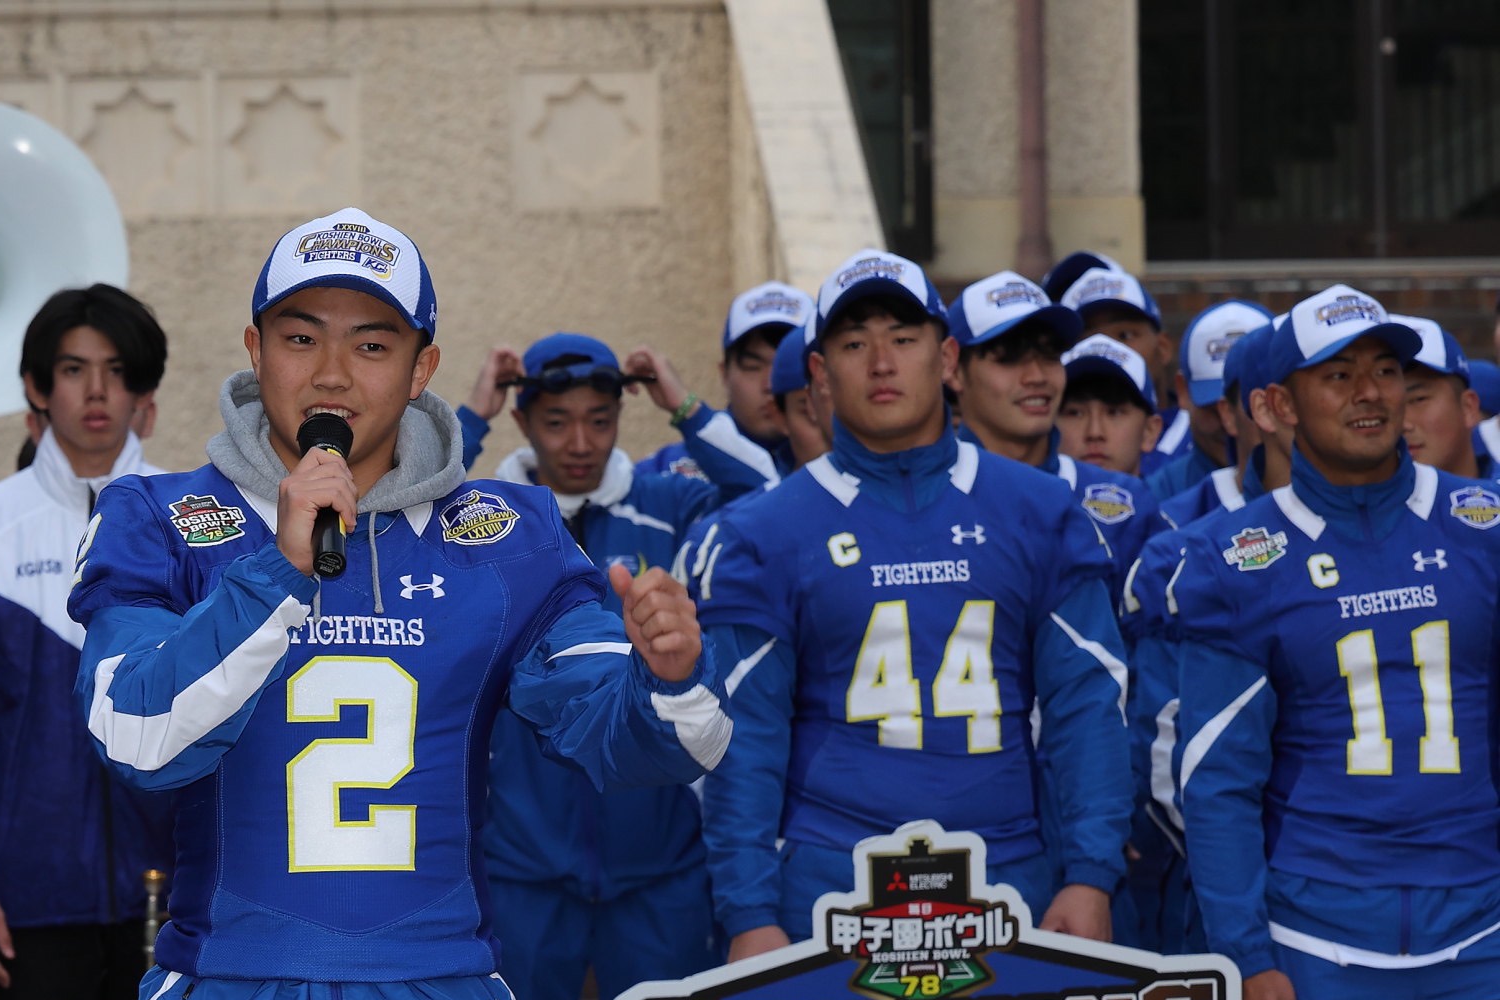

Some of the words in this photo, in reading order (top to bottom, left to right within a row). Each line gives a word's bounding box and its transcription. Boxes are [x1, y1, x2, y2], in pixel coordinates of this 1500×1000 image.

[316, 231, 356, 240] KOSHIEN
[358, 233, 381, 247] BOWL
[336, 224, 367, 233] LXXVIII
[299, 234, 397, 262] CHAMPIONS
[308, 251, 356, 261] FIGHTERS
[190, 520, 230, 533] BOWL
[446, 516, 486, 537] KOSHIEN
[488, 511, 515, 520] BOWL
[458, 507, 495, 525] FIGHTERS
[205, 530, 223, 540] 78
[467, 522, 503, 539] LXXVIII
[827, 531, 862, 568] C
[870, 559, 971, 587] FIGHTERS
[1307, 553, 1341, 589] C
[1337, 585, 1438, 619] FIGHTERS
[845, 599, 1003, 755] 44
[1335, 619, 1462, 777] 11
[285, 655, 419, 874] 2
[831, 908, 1014, 954] 甲子園ボウル
[871, 950, 930, 964] KOSHIEN
[932, 948, 971, 960] BOWL
[900, 974, 941, 997] 78
